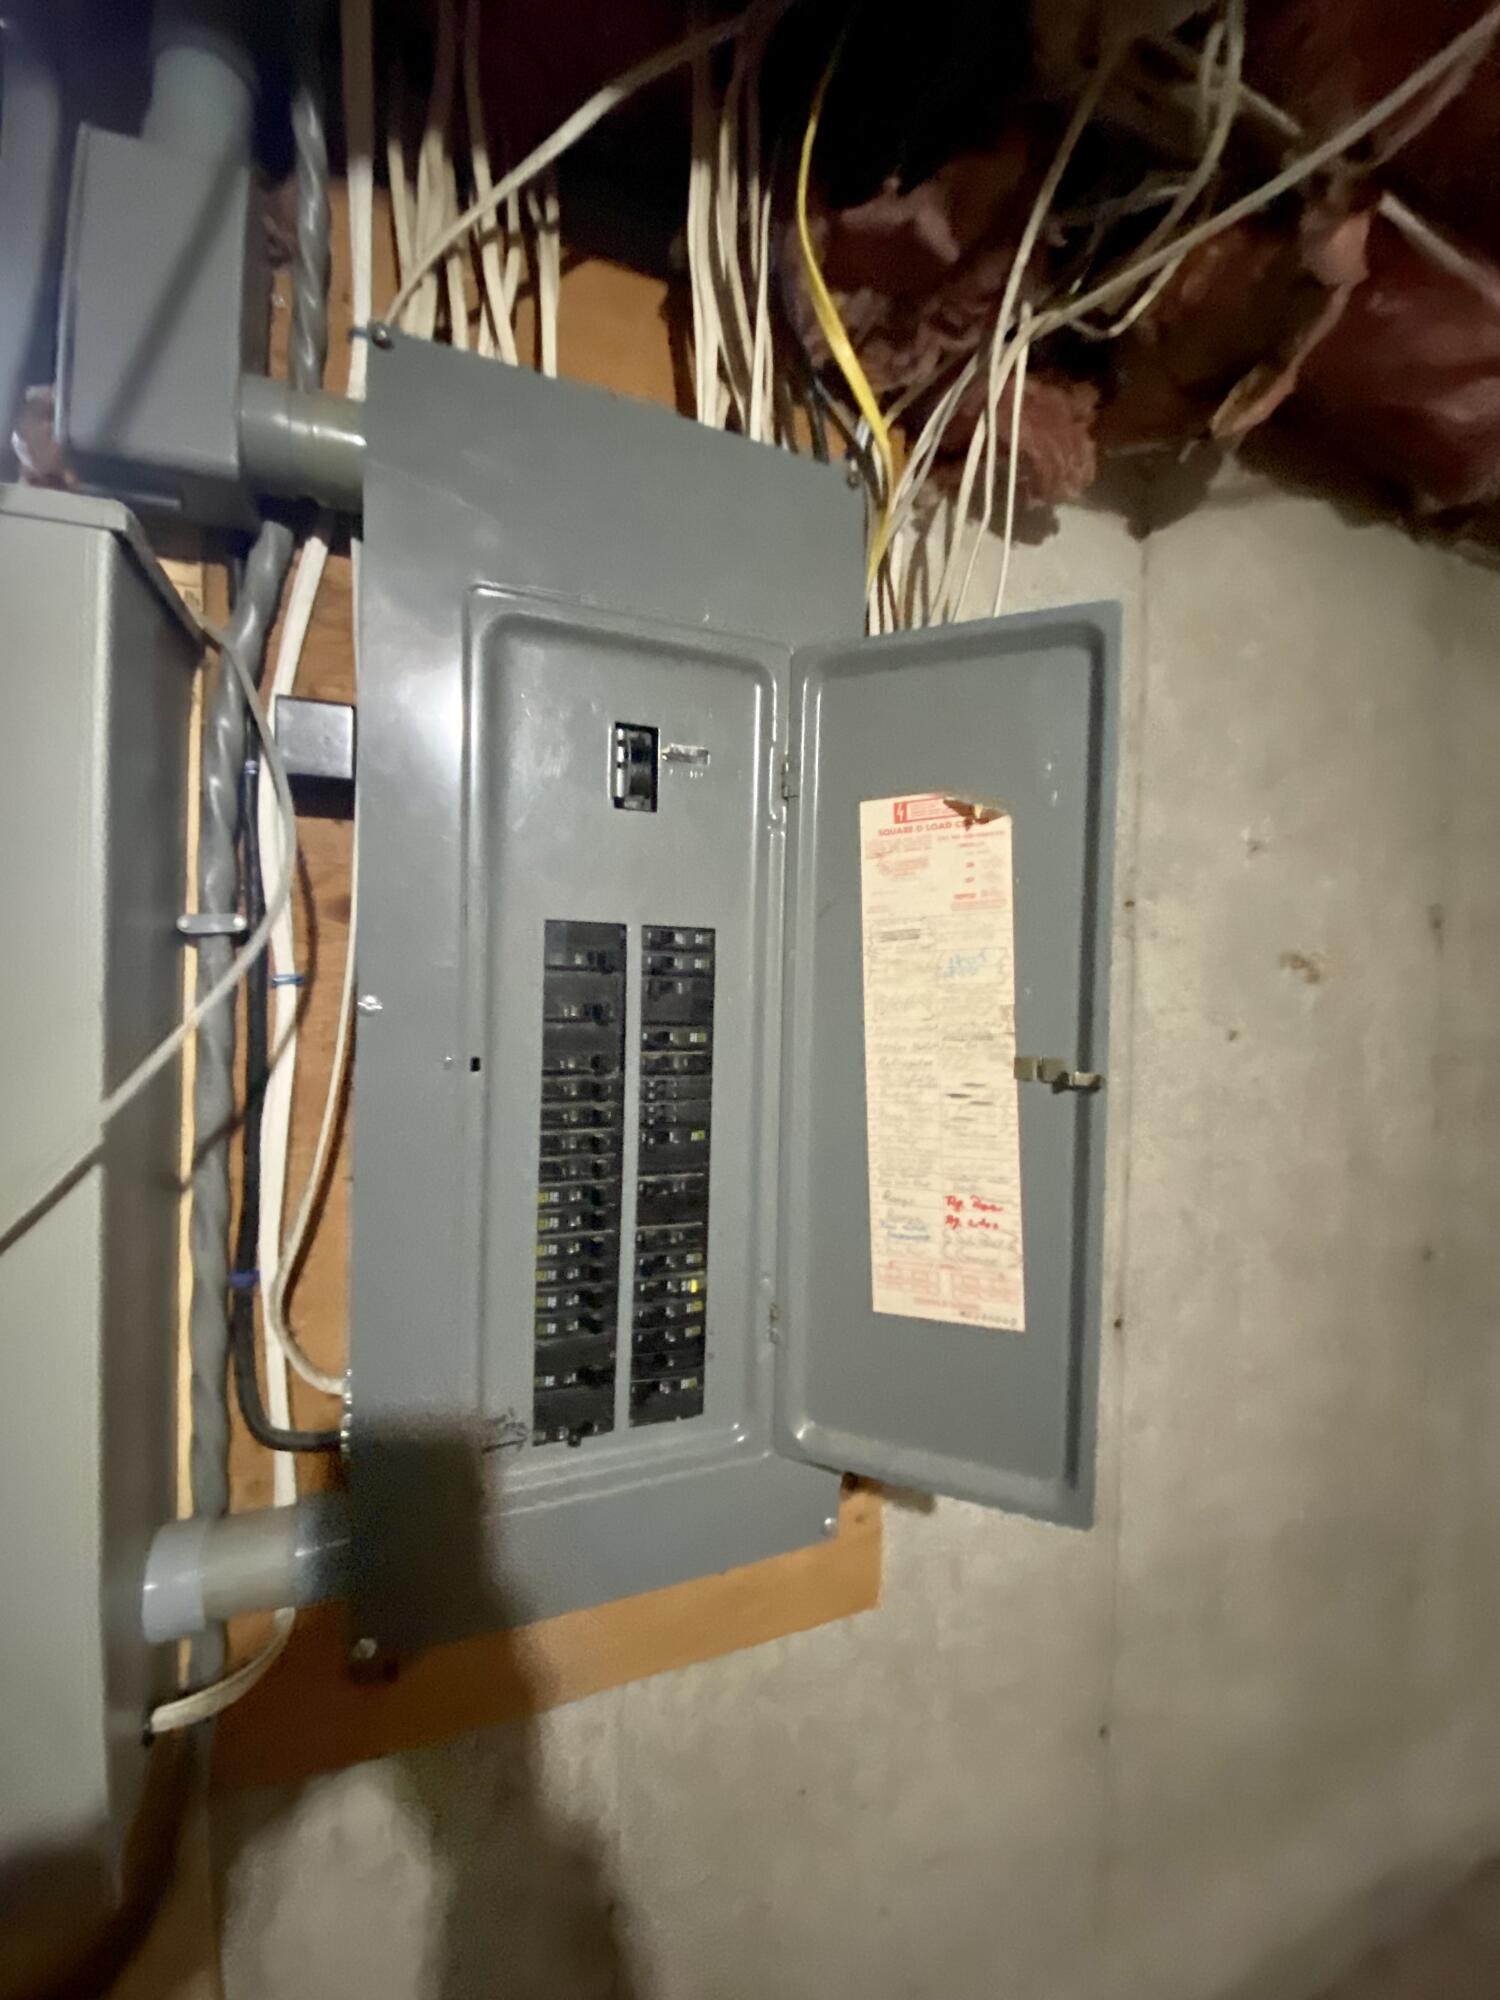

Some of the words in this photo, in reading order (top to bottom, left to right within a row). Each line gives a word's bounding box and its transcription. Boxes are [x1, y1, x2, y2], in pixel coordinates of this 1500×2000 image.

[879, 825, 913, 837] SQUARE
[916, 824, 923, 833] D
[926, 821, 952, 832] LOAD
